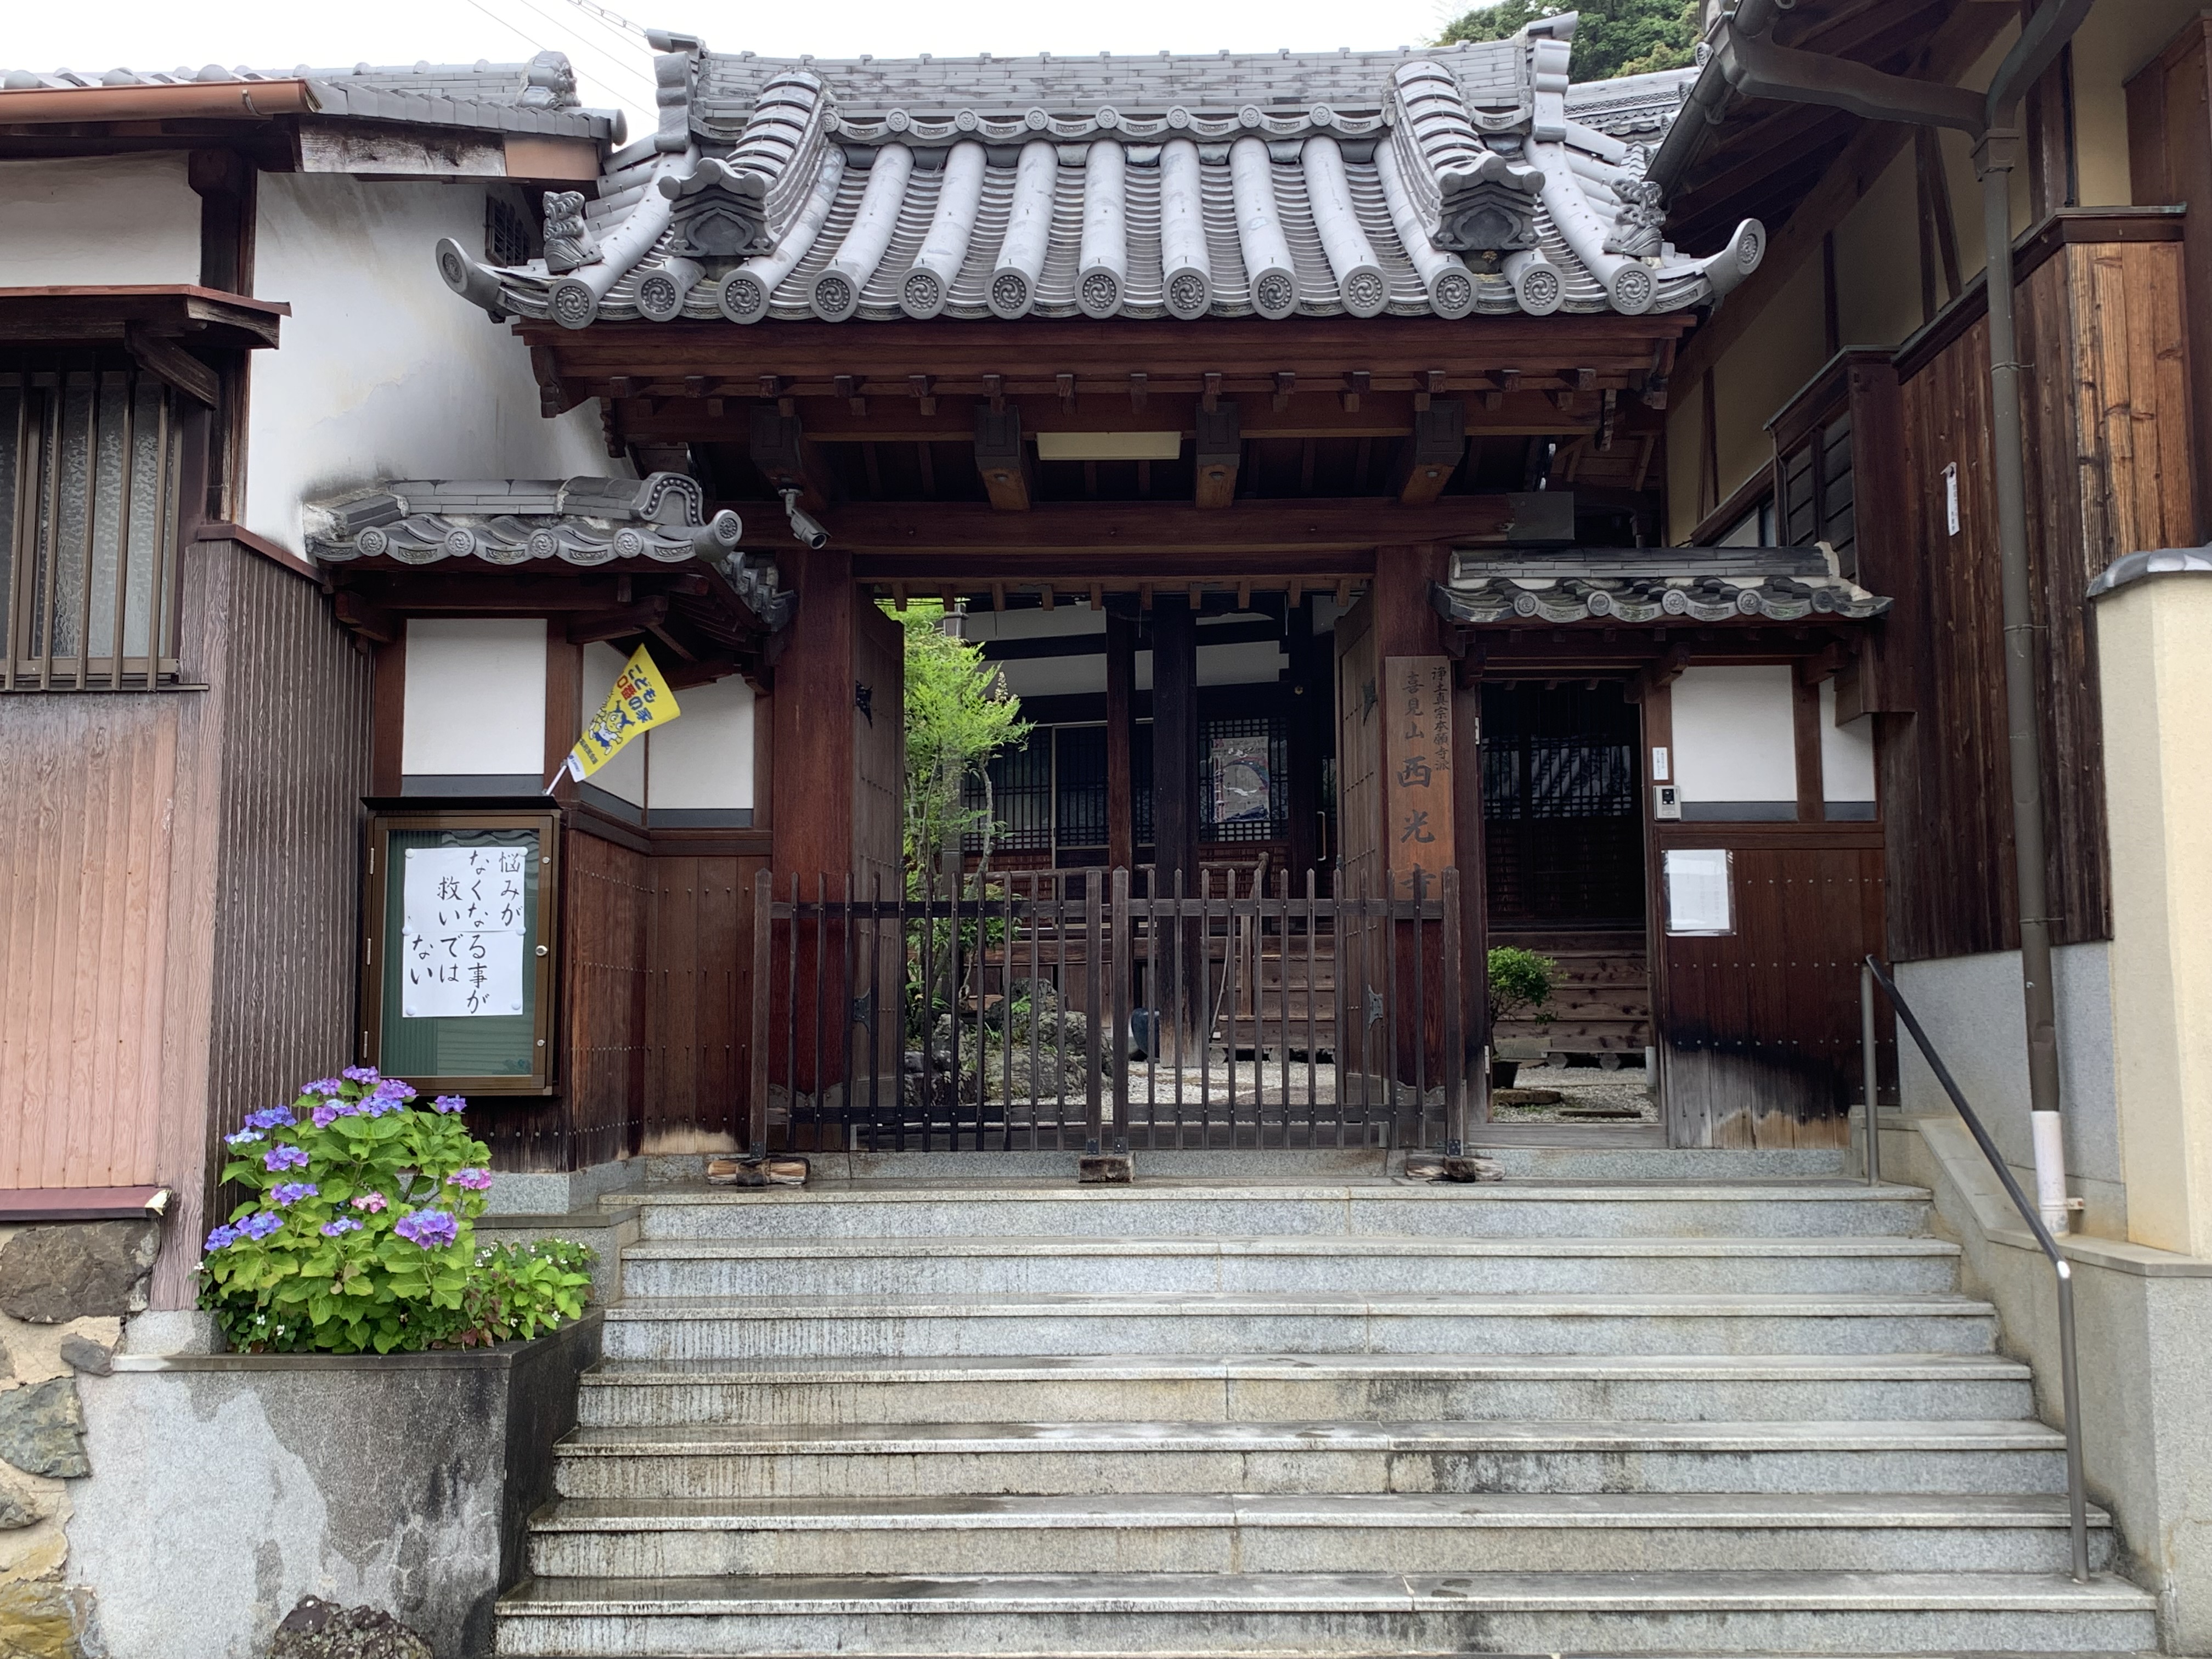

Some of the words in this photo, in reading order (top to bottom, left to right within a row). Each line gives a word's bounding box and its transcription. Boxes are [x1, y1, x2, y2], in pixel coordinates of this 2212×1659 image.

[617, 675, 653, 724] 0番の家
[628, 664, 656, 703] こども
[1431, 667, 1449, 771] 浄土真宗本願寺派
[499, 851, 522, 926] 悩みが
[410, 934, 433, 985] ない
[437, 876, 463, 983] 救いでは
[466, 850, 490, 1014] なくなる事が
